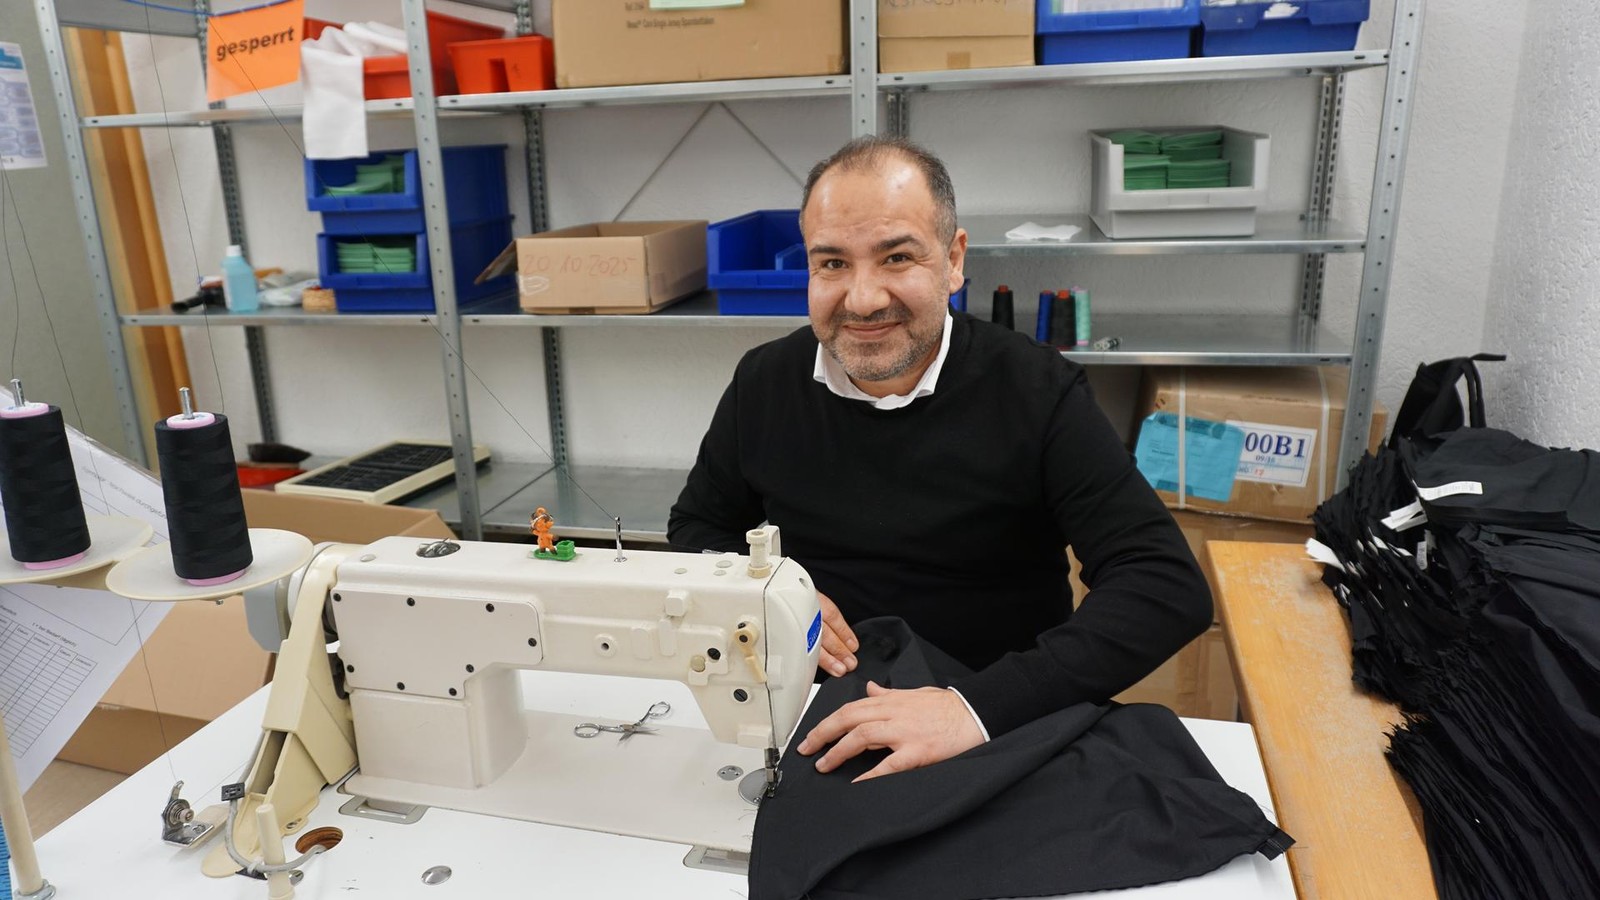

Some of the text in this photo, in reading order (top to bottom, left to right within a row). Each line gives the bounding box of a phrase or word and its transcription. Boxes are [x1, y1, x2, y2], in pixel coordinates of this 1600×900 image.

[216, 26, 295, 62] gesperrt
[523, 254, 637, 277] 20 10 2025
[1244, 432, 1306, 458] 00B1
